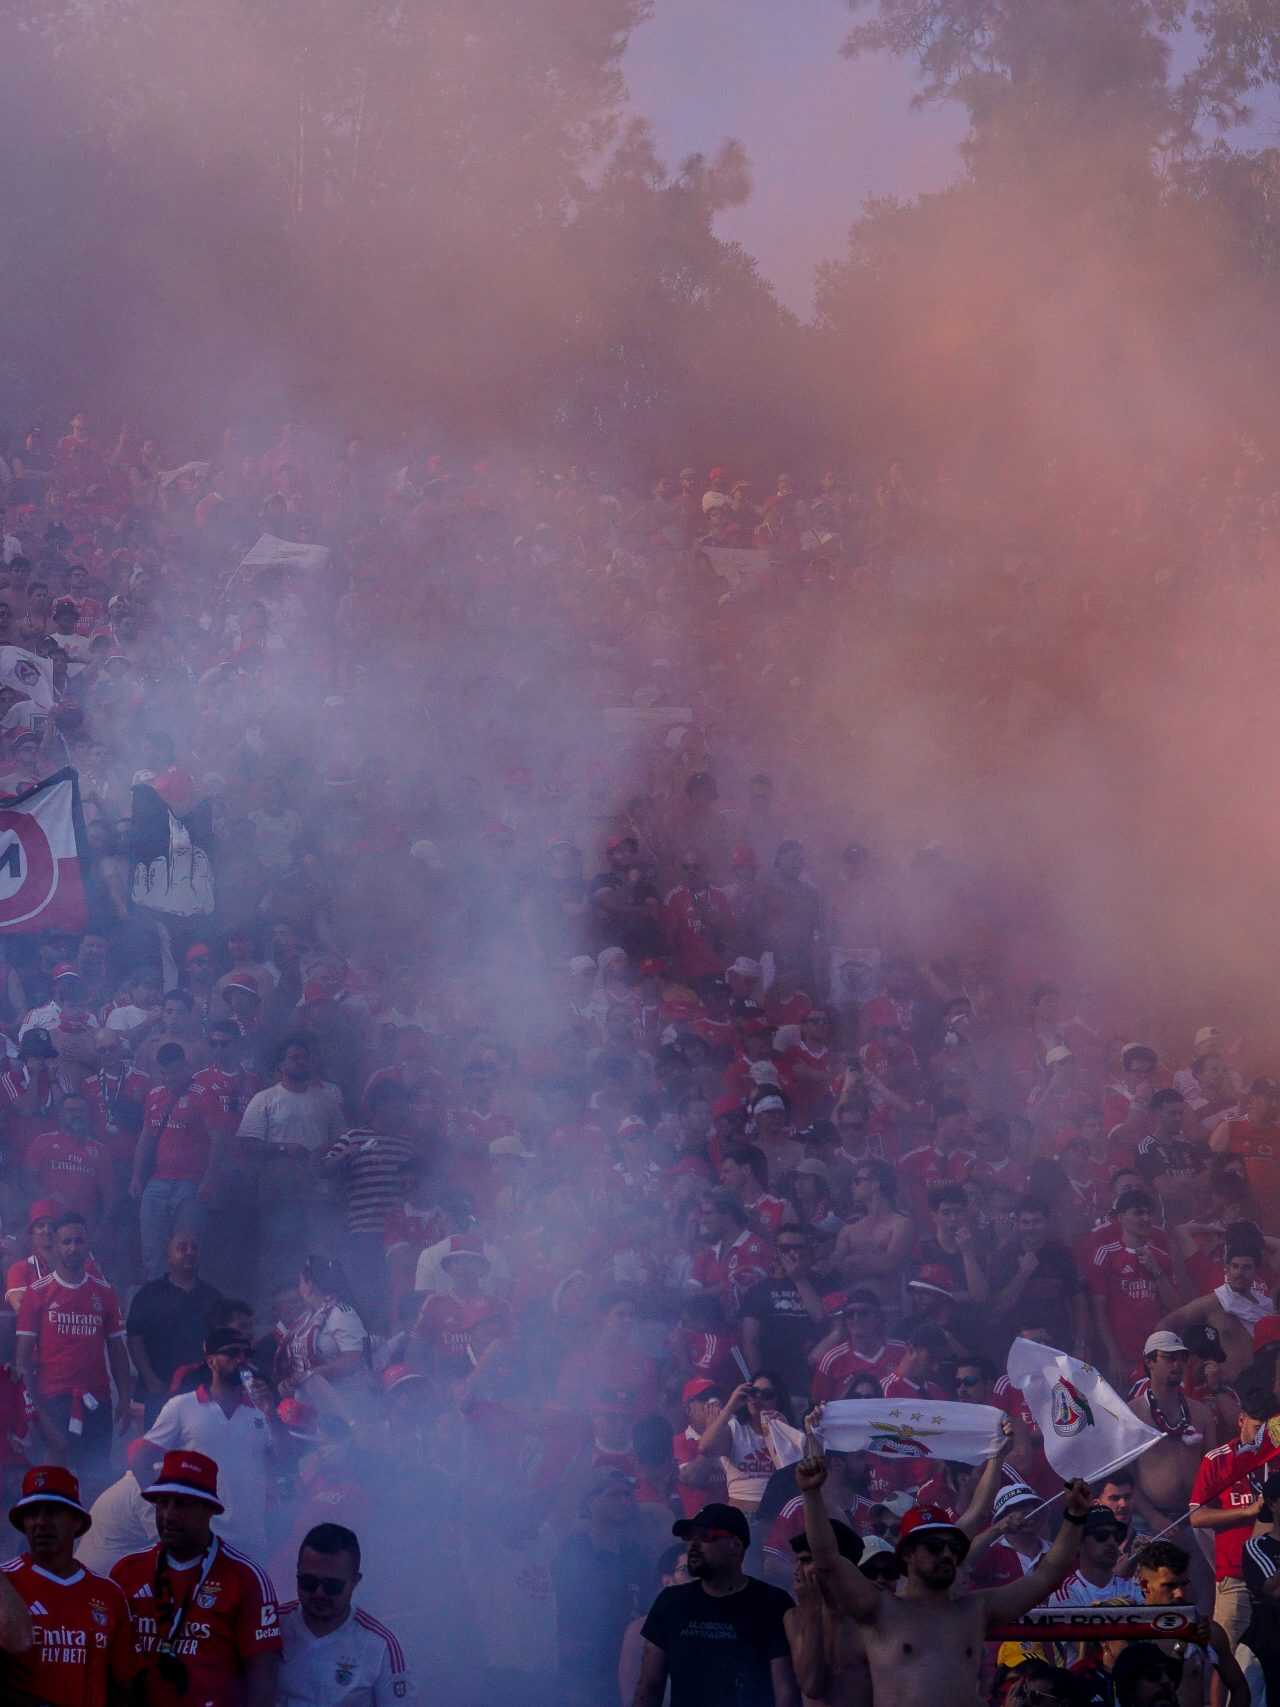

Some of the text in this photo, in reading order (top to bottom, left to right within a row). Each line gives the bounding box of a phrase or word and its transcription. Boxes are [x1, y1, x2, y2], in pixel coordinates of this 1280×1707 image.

[48, 1311, 104, 1326] Emirates
[255, 1628, 281, 1641] Betan
[41, 1647, 88, 1664] FLY BETT
